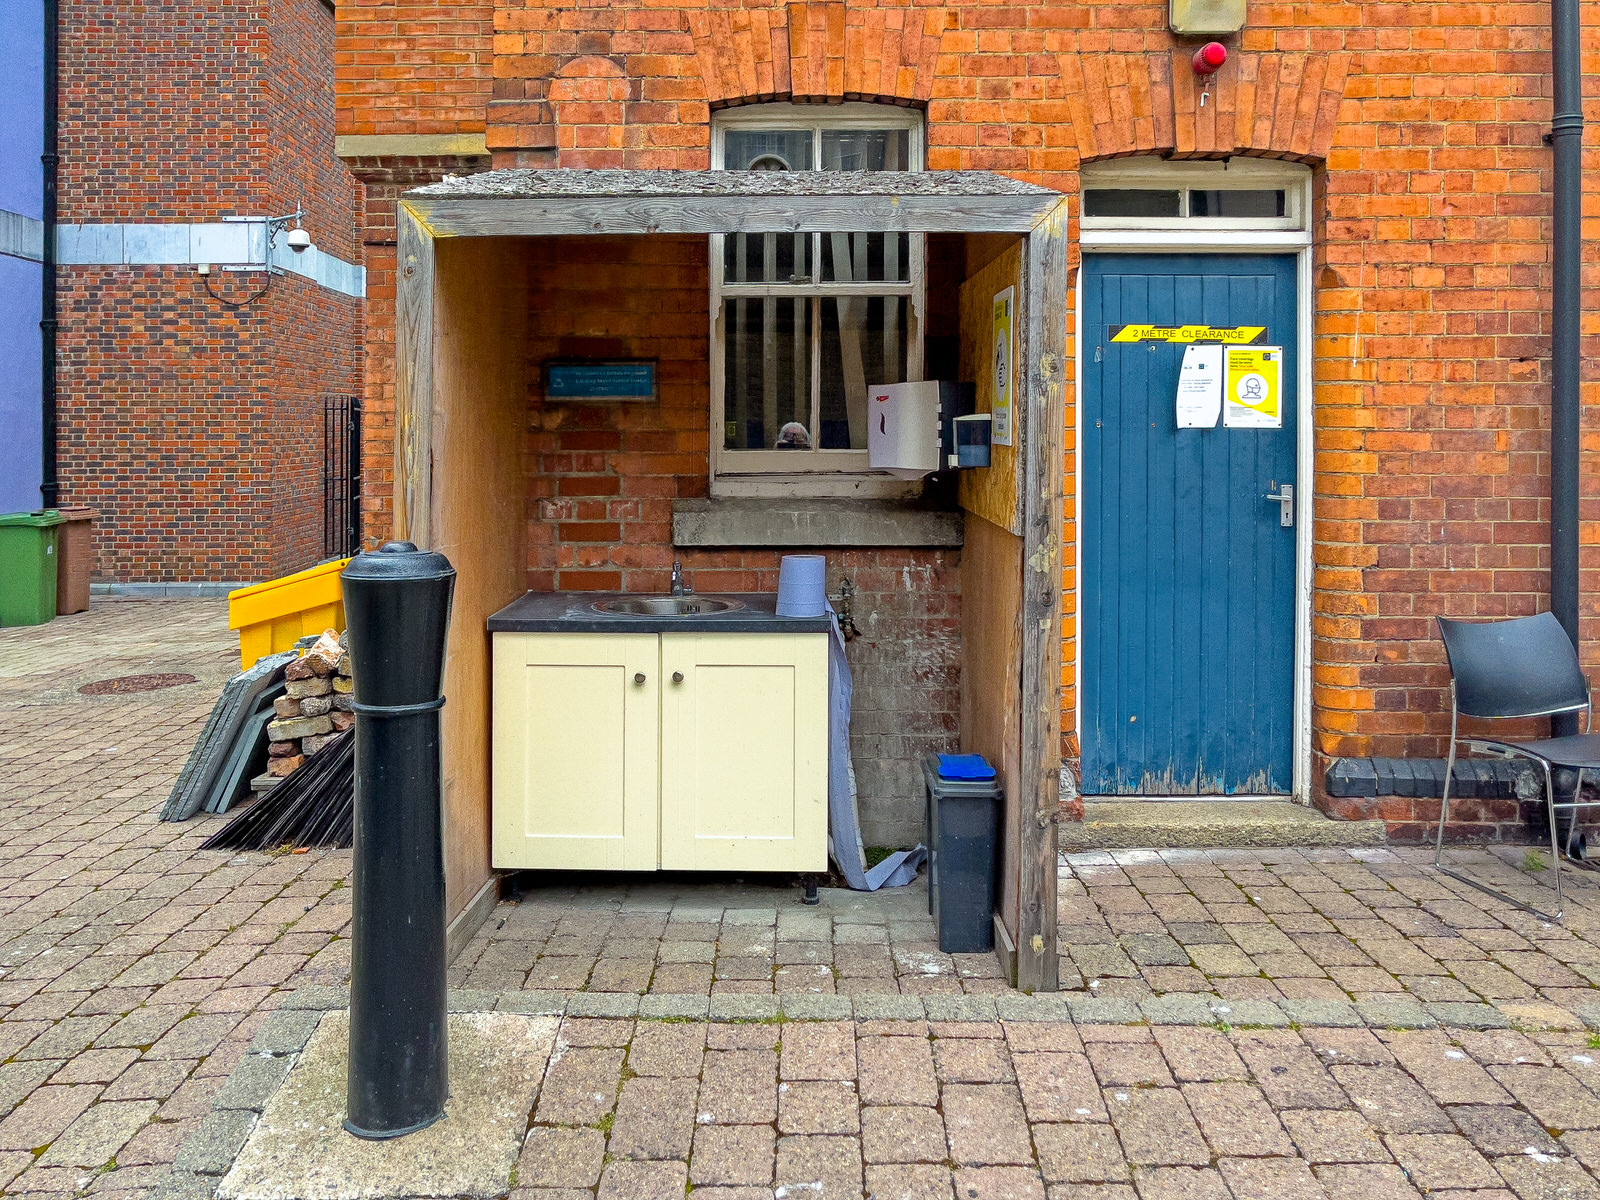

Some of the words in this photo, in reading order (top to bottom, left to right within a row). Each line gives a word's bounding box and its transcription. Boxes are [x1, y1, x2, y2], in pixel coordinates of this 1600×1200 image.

[1132, 329, 1139, 338] 2
[1141, 329, 1176, 338] METRE
[1181, 329, 1245, 339] CLEARANCE
